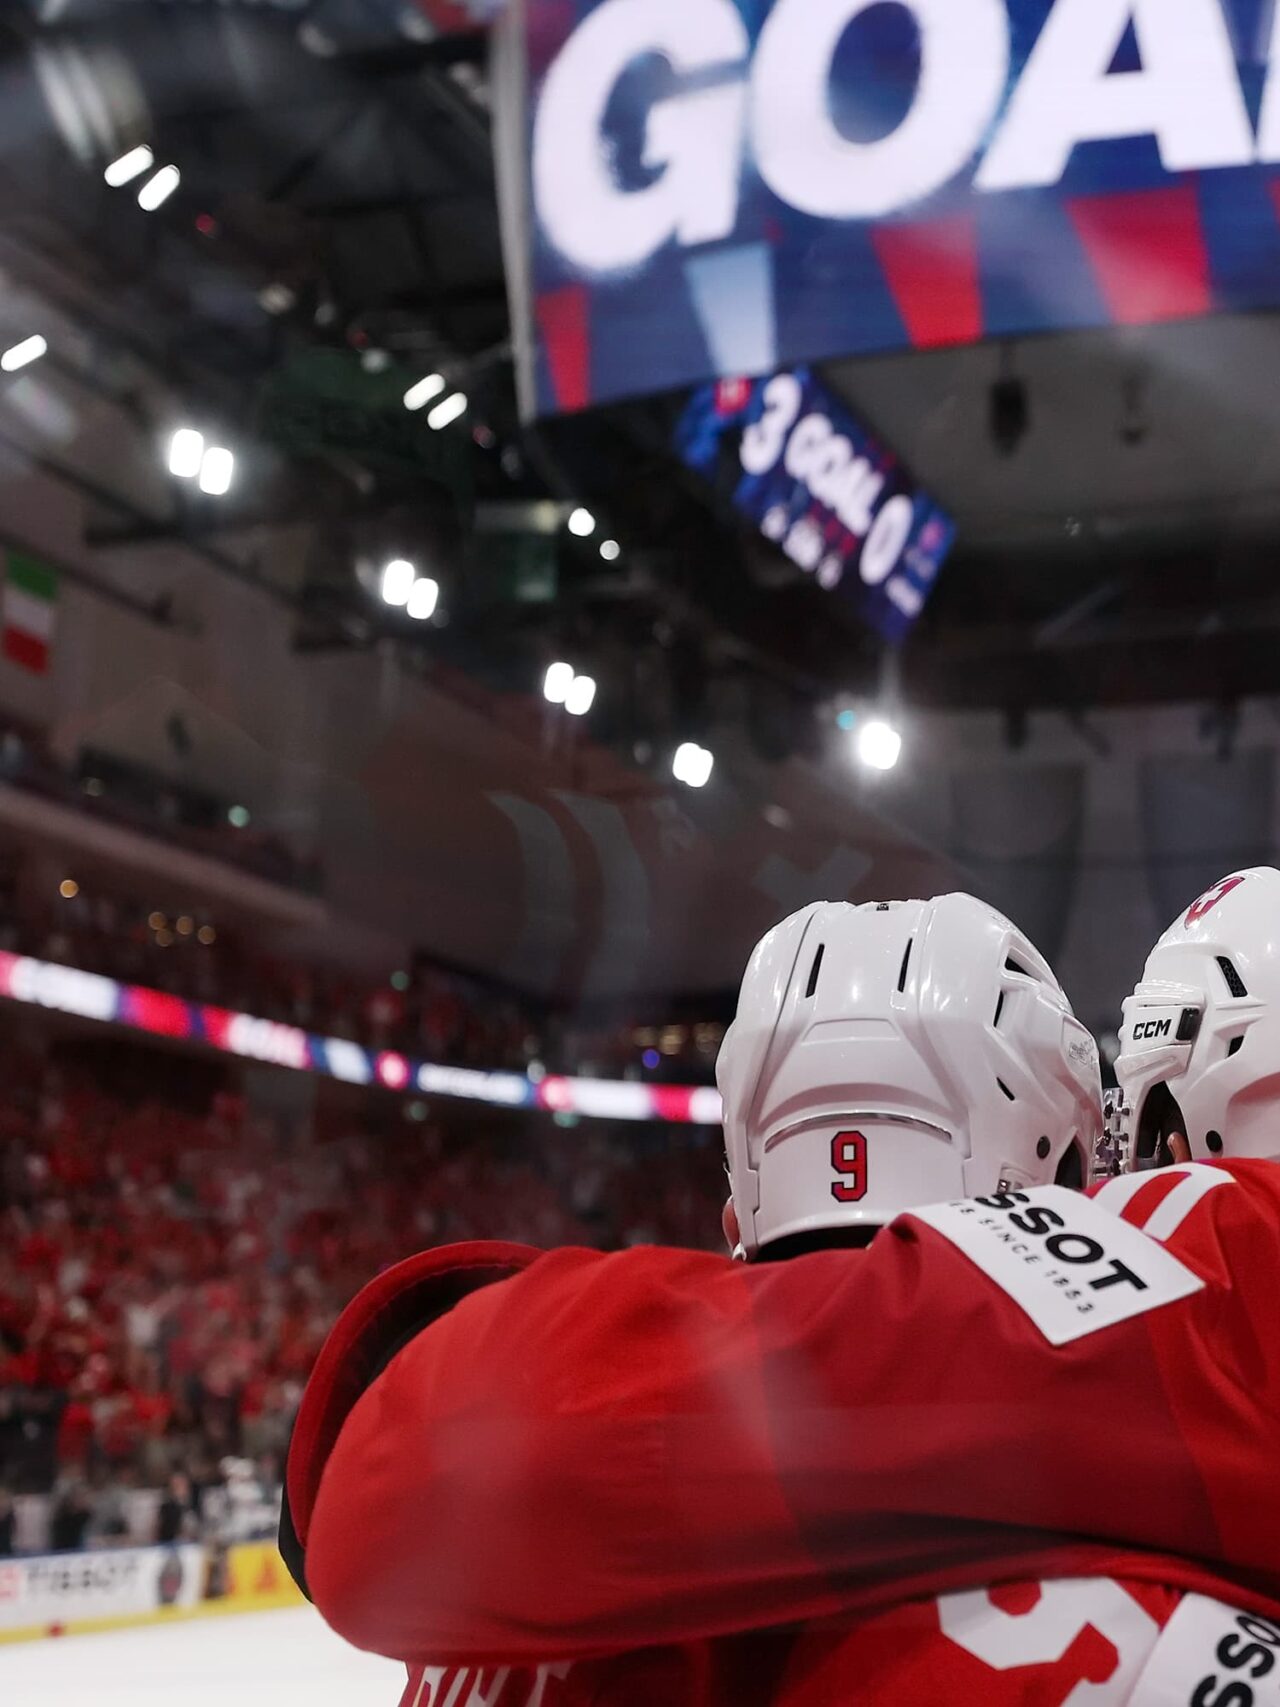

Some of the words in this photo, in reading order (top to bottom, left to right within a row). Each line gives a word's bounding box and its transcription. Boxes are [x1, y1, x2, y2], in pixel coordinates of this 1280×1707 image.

[739, 373, 800, 475] 3
[784, 412, 885, 537] GOAL
[1132, 1018, 1172, 1041] CCM
[831, 1130, 867, 1202] 9
[978, 1218, 1041, 1265] SINCE
[1045, 1269, 1095, 1314] 1853
